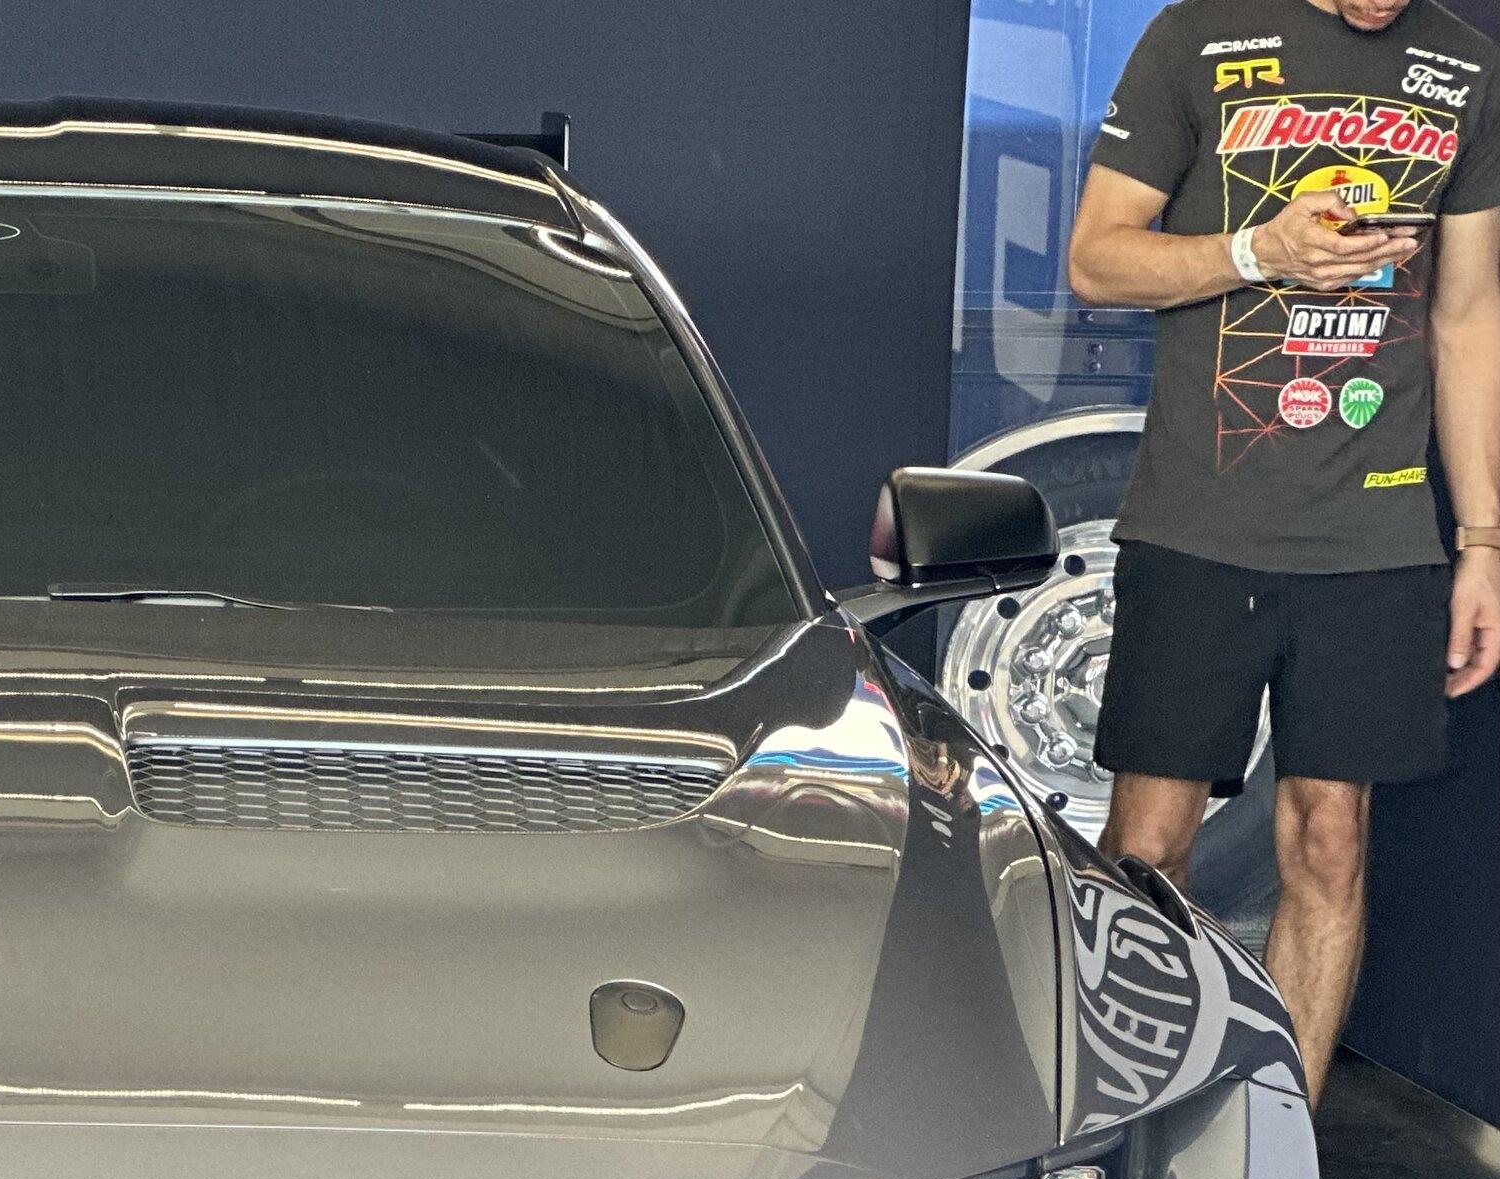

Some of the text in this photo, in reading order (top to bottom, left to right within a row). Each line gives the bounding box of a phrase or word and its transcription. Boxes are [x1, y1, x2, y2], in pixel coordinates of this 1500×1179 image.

[1401, 63, 1471, 108] Ford
[1261, 104, 1459, 165] AutoZone
[1292, 310, 1383, 338] OPTIMA
[1307, 342, 1365, 353] BATTERIES
[1287, 389, 1323, 403] NGK
[1348, 389, 1377, 403] NTK
